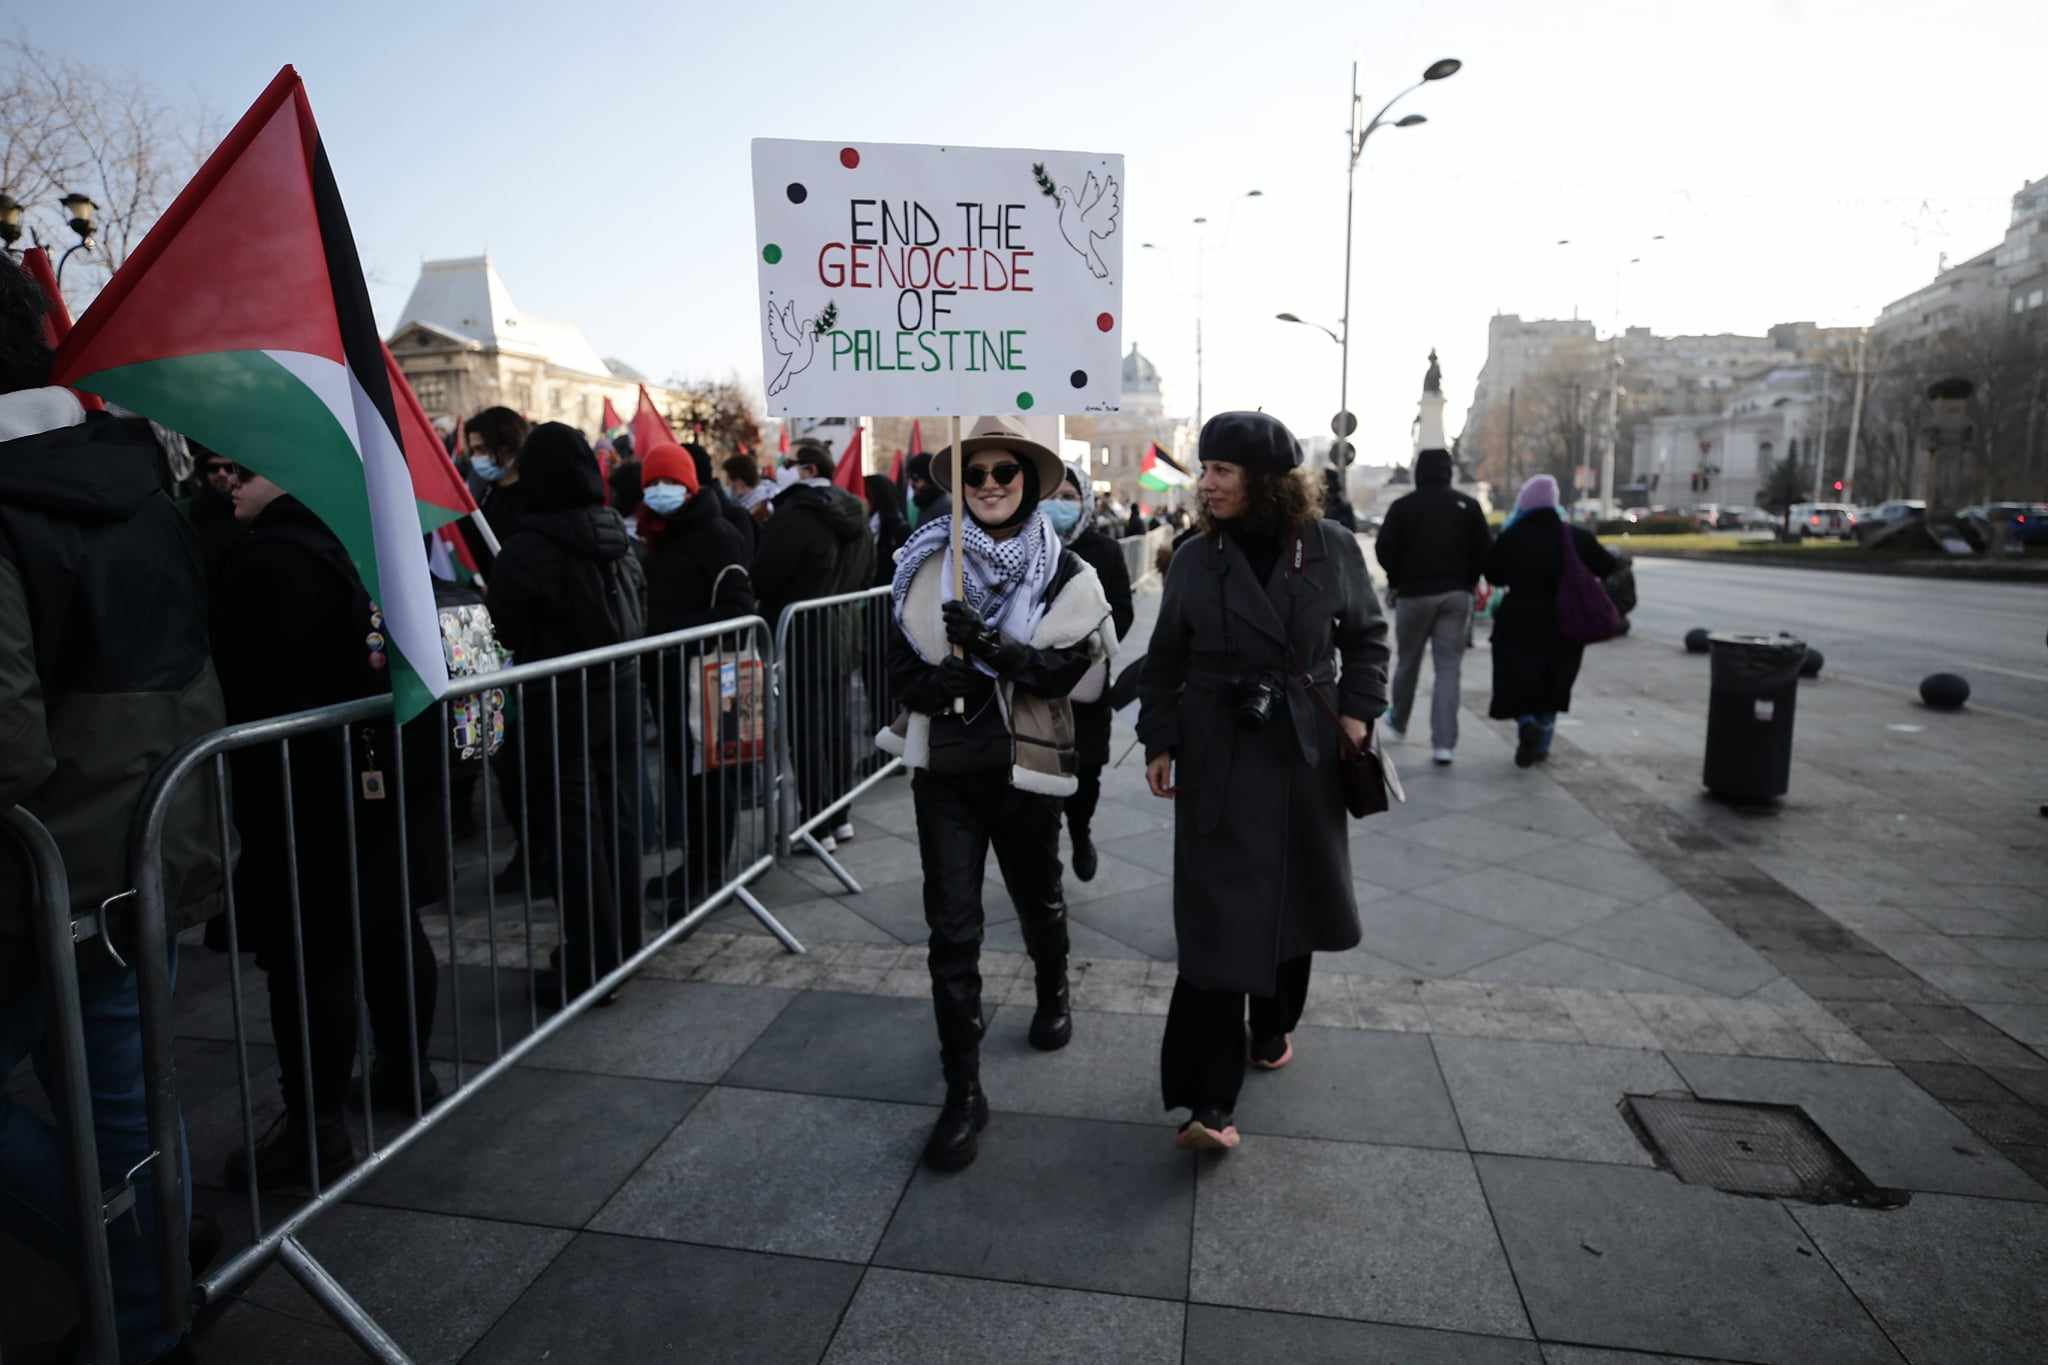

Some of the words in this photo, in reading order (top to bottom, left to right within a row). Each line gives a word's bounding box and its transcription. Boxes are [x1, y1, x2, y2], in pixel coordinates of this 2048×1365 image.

[851, 199, 940, 247] END
[956, 202, 1027, 250] THE
[818, 242, 1035, 292] GENOCIDE
[898, 288, 957, 331] OF
[826, 329, 1027, 372] PALESTINE
